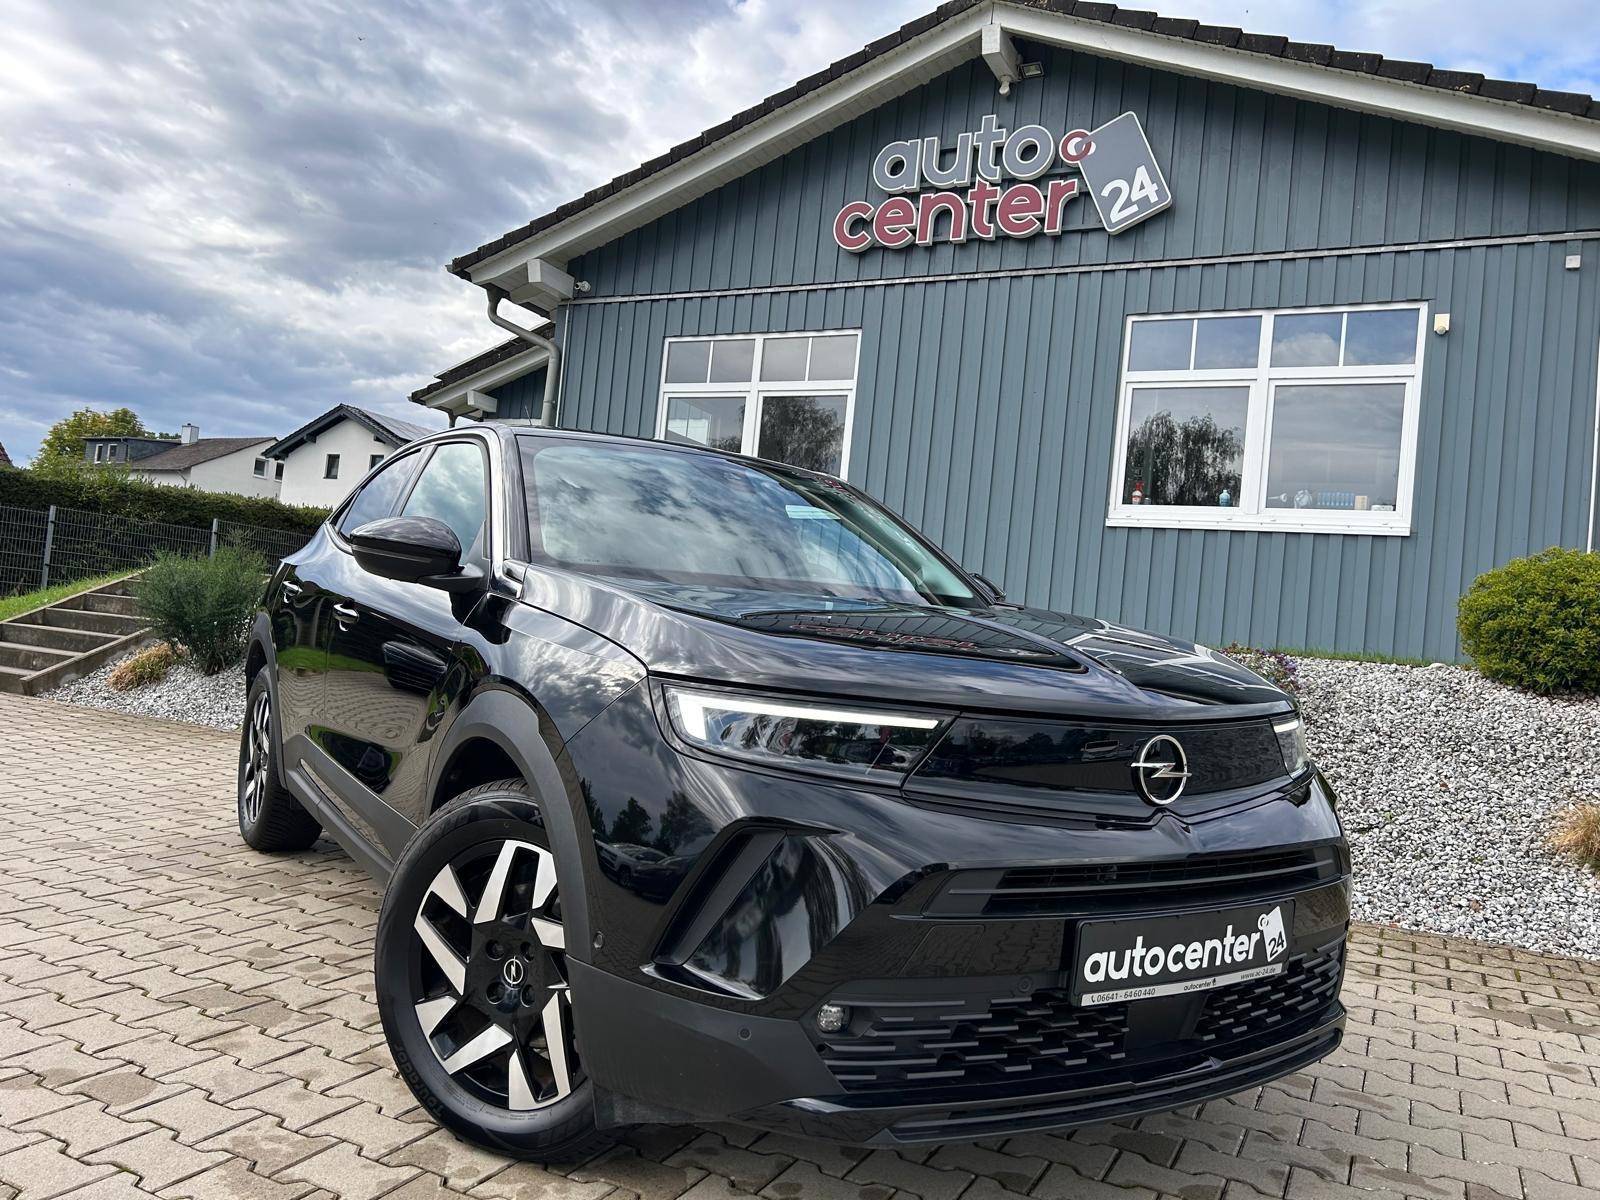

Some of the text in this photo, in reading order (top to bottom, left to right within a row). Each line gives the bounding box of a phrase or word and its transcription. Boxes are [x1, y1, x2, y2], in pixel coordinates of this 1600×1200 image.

[872, 114, 1057, 195] auto
[833, 174, 1081, 253] center
[1101, 165, 1160, 224] 24
[1083, 924, 1285, 984] autocenter 24
[1183, 980, 1212, 991] autocenter
